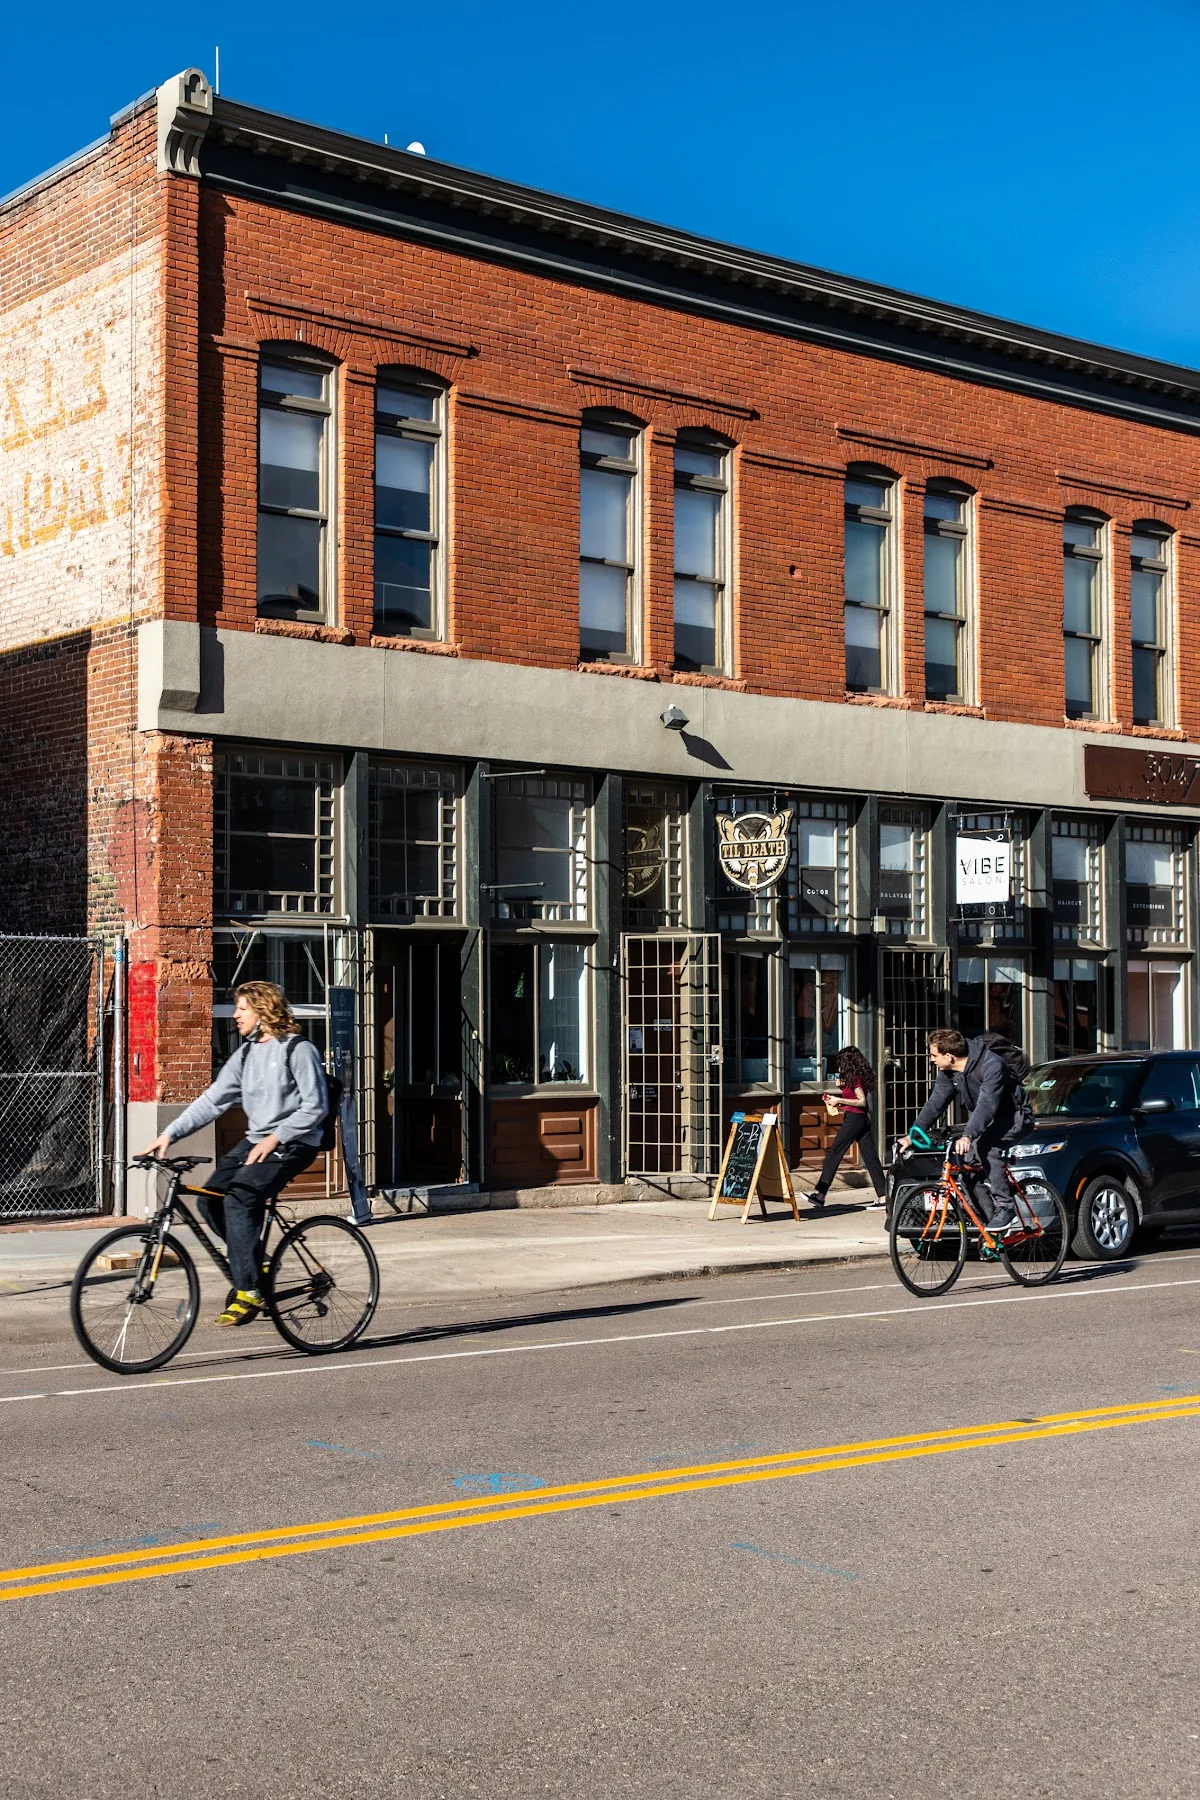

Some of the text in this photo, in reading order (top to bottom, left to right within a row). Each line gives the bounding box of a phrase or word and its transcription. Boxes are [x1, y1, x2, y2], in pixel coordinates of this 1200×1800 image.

[722, 841, 785, 858] TIL DEATH
[960, 856, 1005, 875] VIBE
[962, 876, 1002, 886] SALON
[964, 905, 1004, 915] SALON
